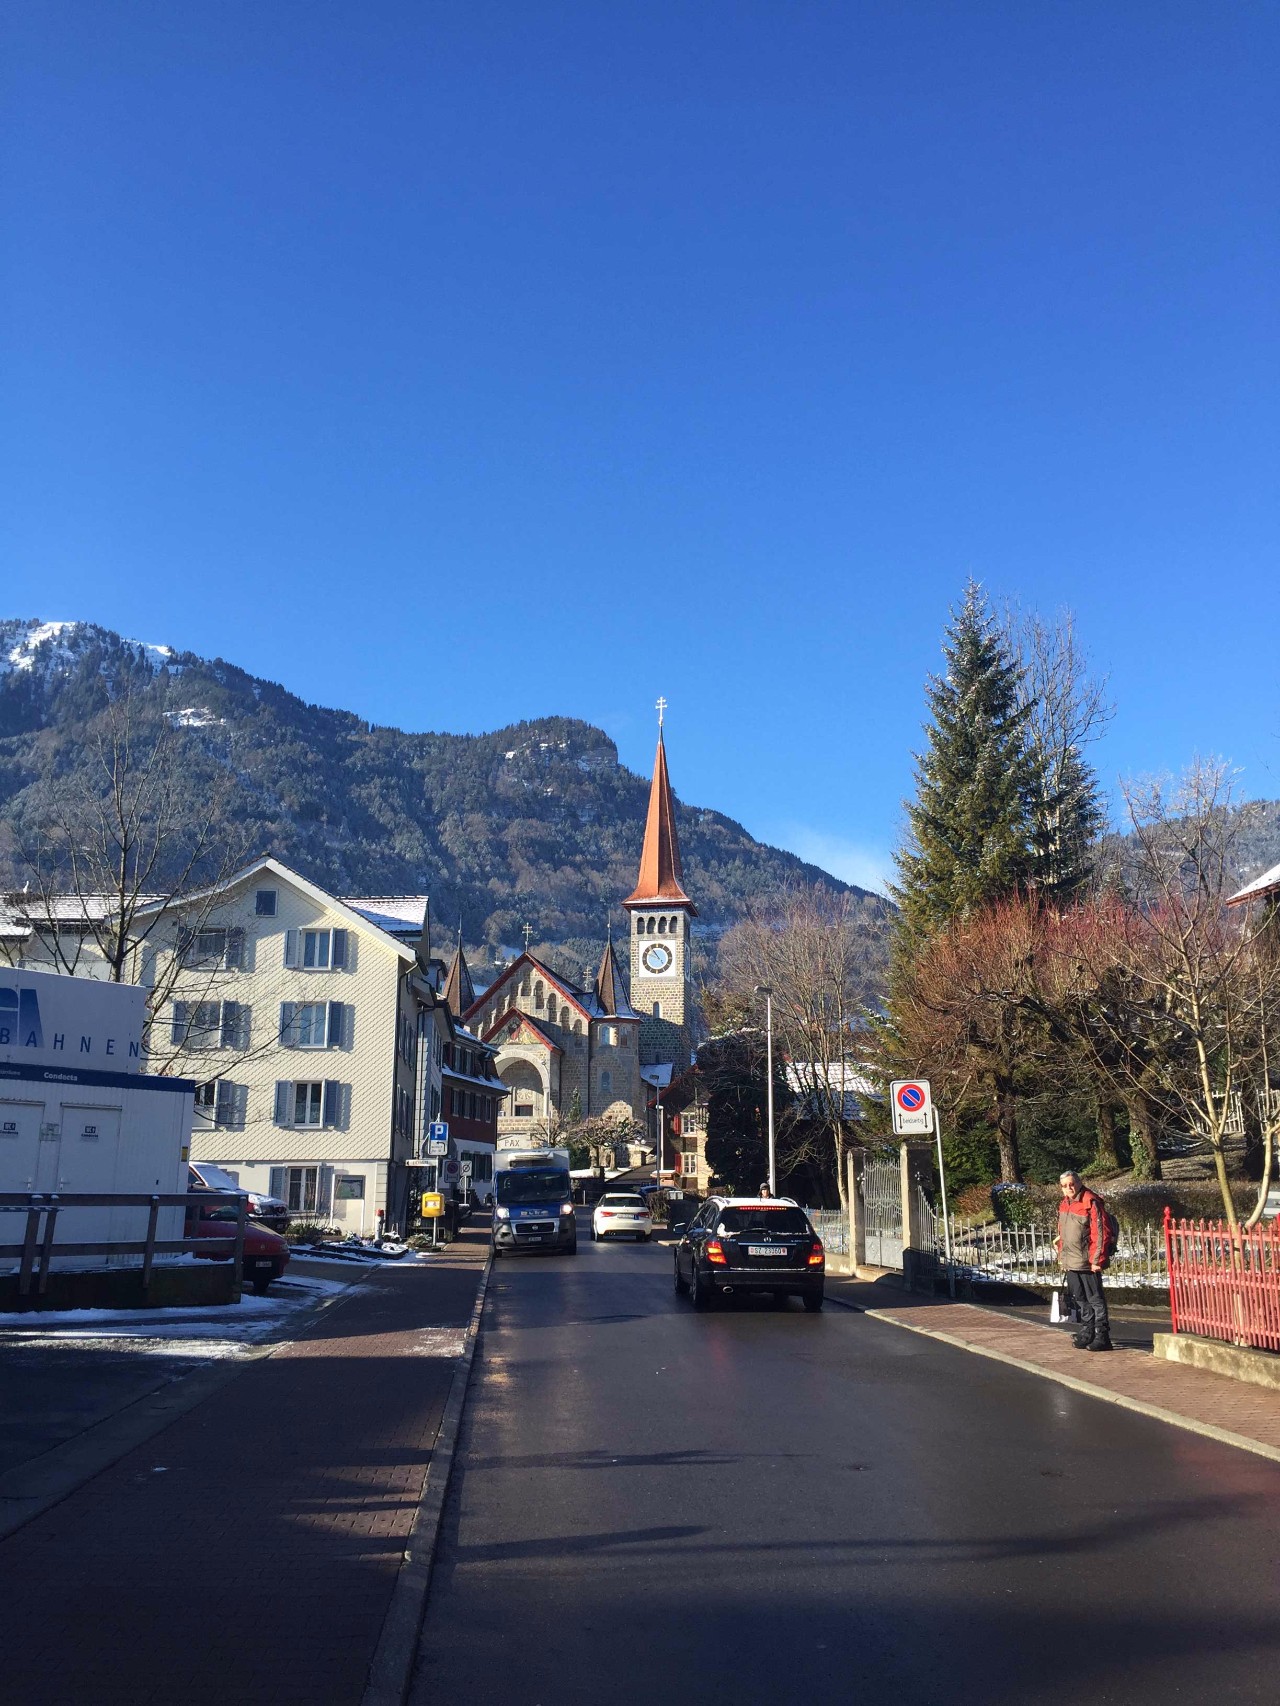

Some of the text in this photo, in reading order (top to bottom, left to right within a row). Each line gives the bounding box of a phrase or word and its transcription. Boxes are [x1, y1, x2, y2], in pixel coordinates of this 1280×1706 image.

[43, 1071, 78, 1082] Condecta
[434, 1125, 444, 1139] P
[504, 1139, 520, 1147] PAX
